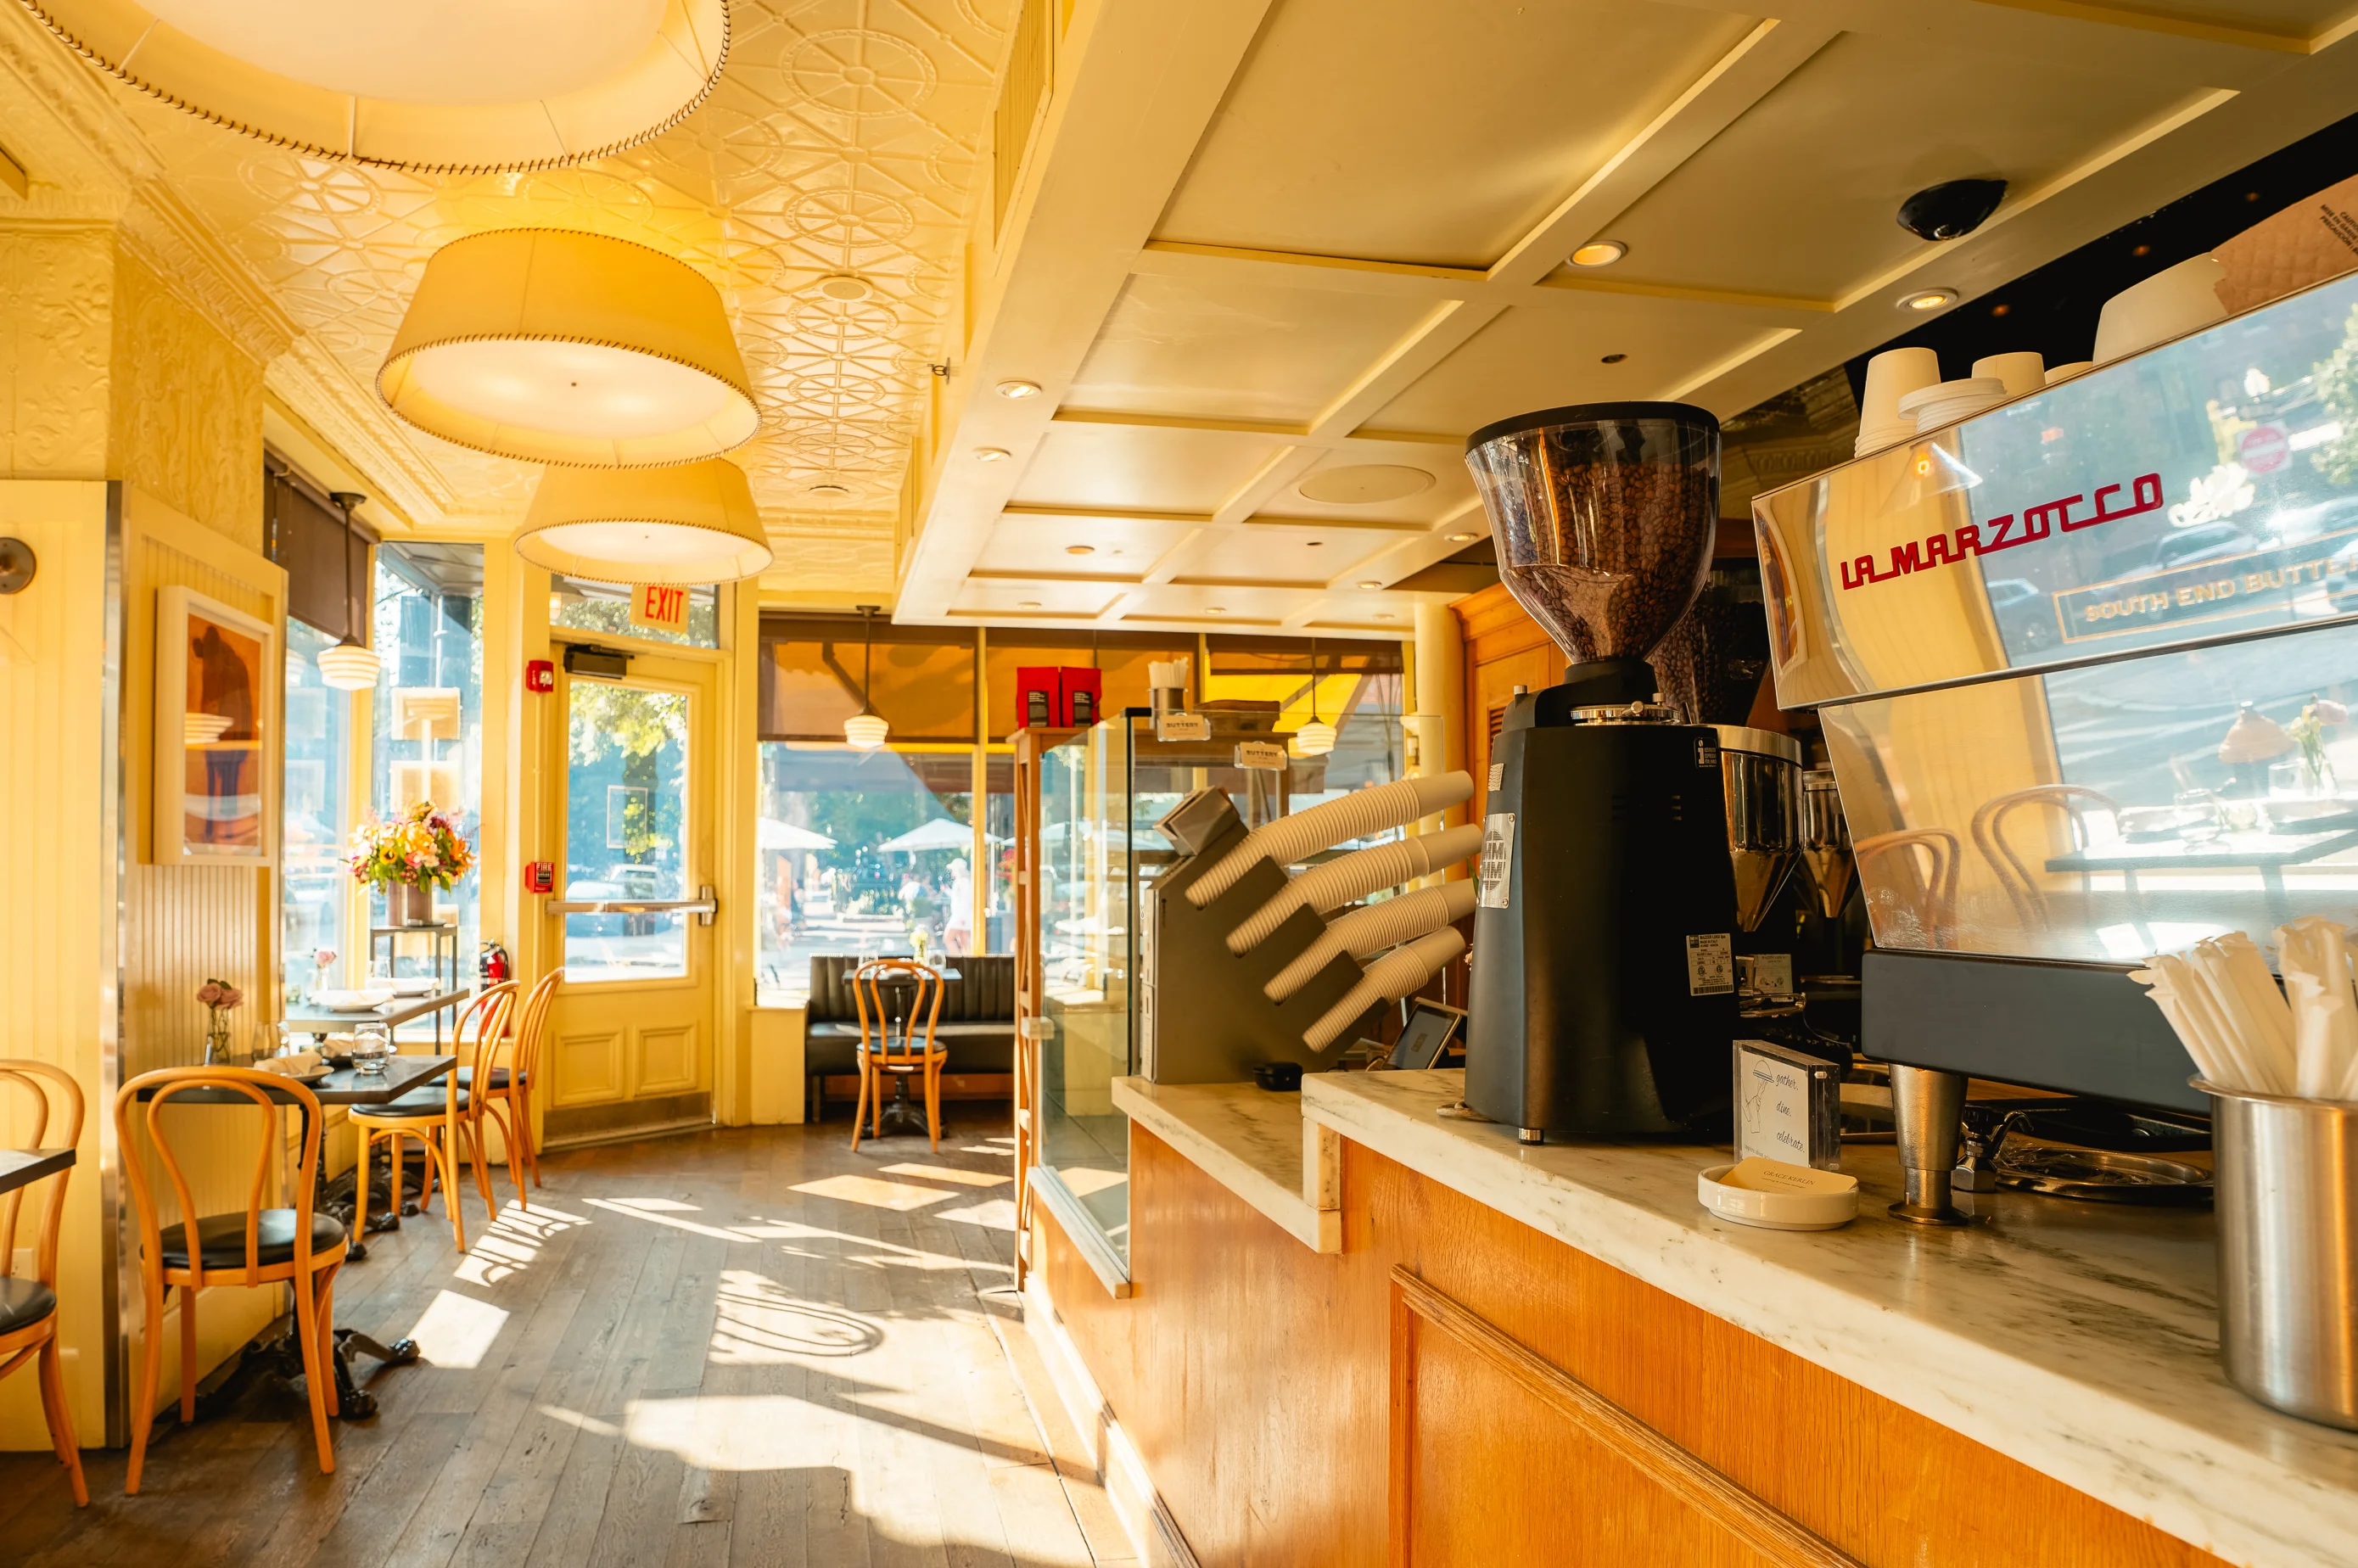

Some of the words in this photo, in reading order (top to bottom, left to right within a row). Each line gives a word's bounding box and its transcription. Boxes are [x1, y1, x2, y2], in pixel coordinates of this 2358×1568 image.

[1840, 554, 1875, 591] LA
[645, 585, 684, 624] EXIT
[2084, 591, 2170, 623] SOUTH
[2176, 578, 2237, 607] END
[536, 862, 552, 871] FIRE
[1776, 1073, 1799, 1091] gather.
[1776, 1100, 1792, 1117] dine.
[1776, 1130, 1805, 1153] celebrate.
[1763, 1170, 1788, 1179] GRACE
[1787, 1175, 1816, 1185] KERLIN
